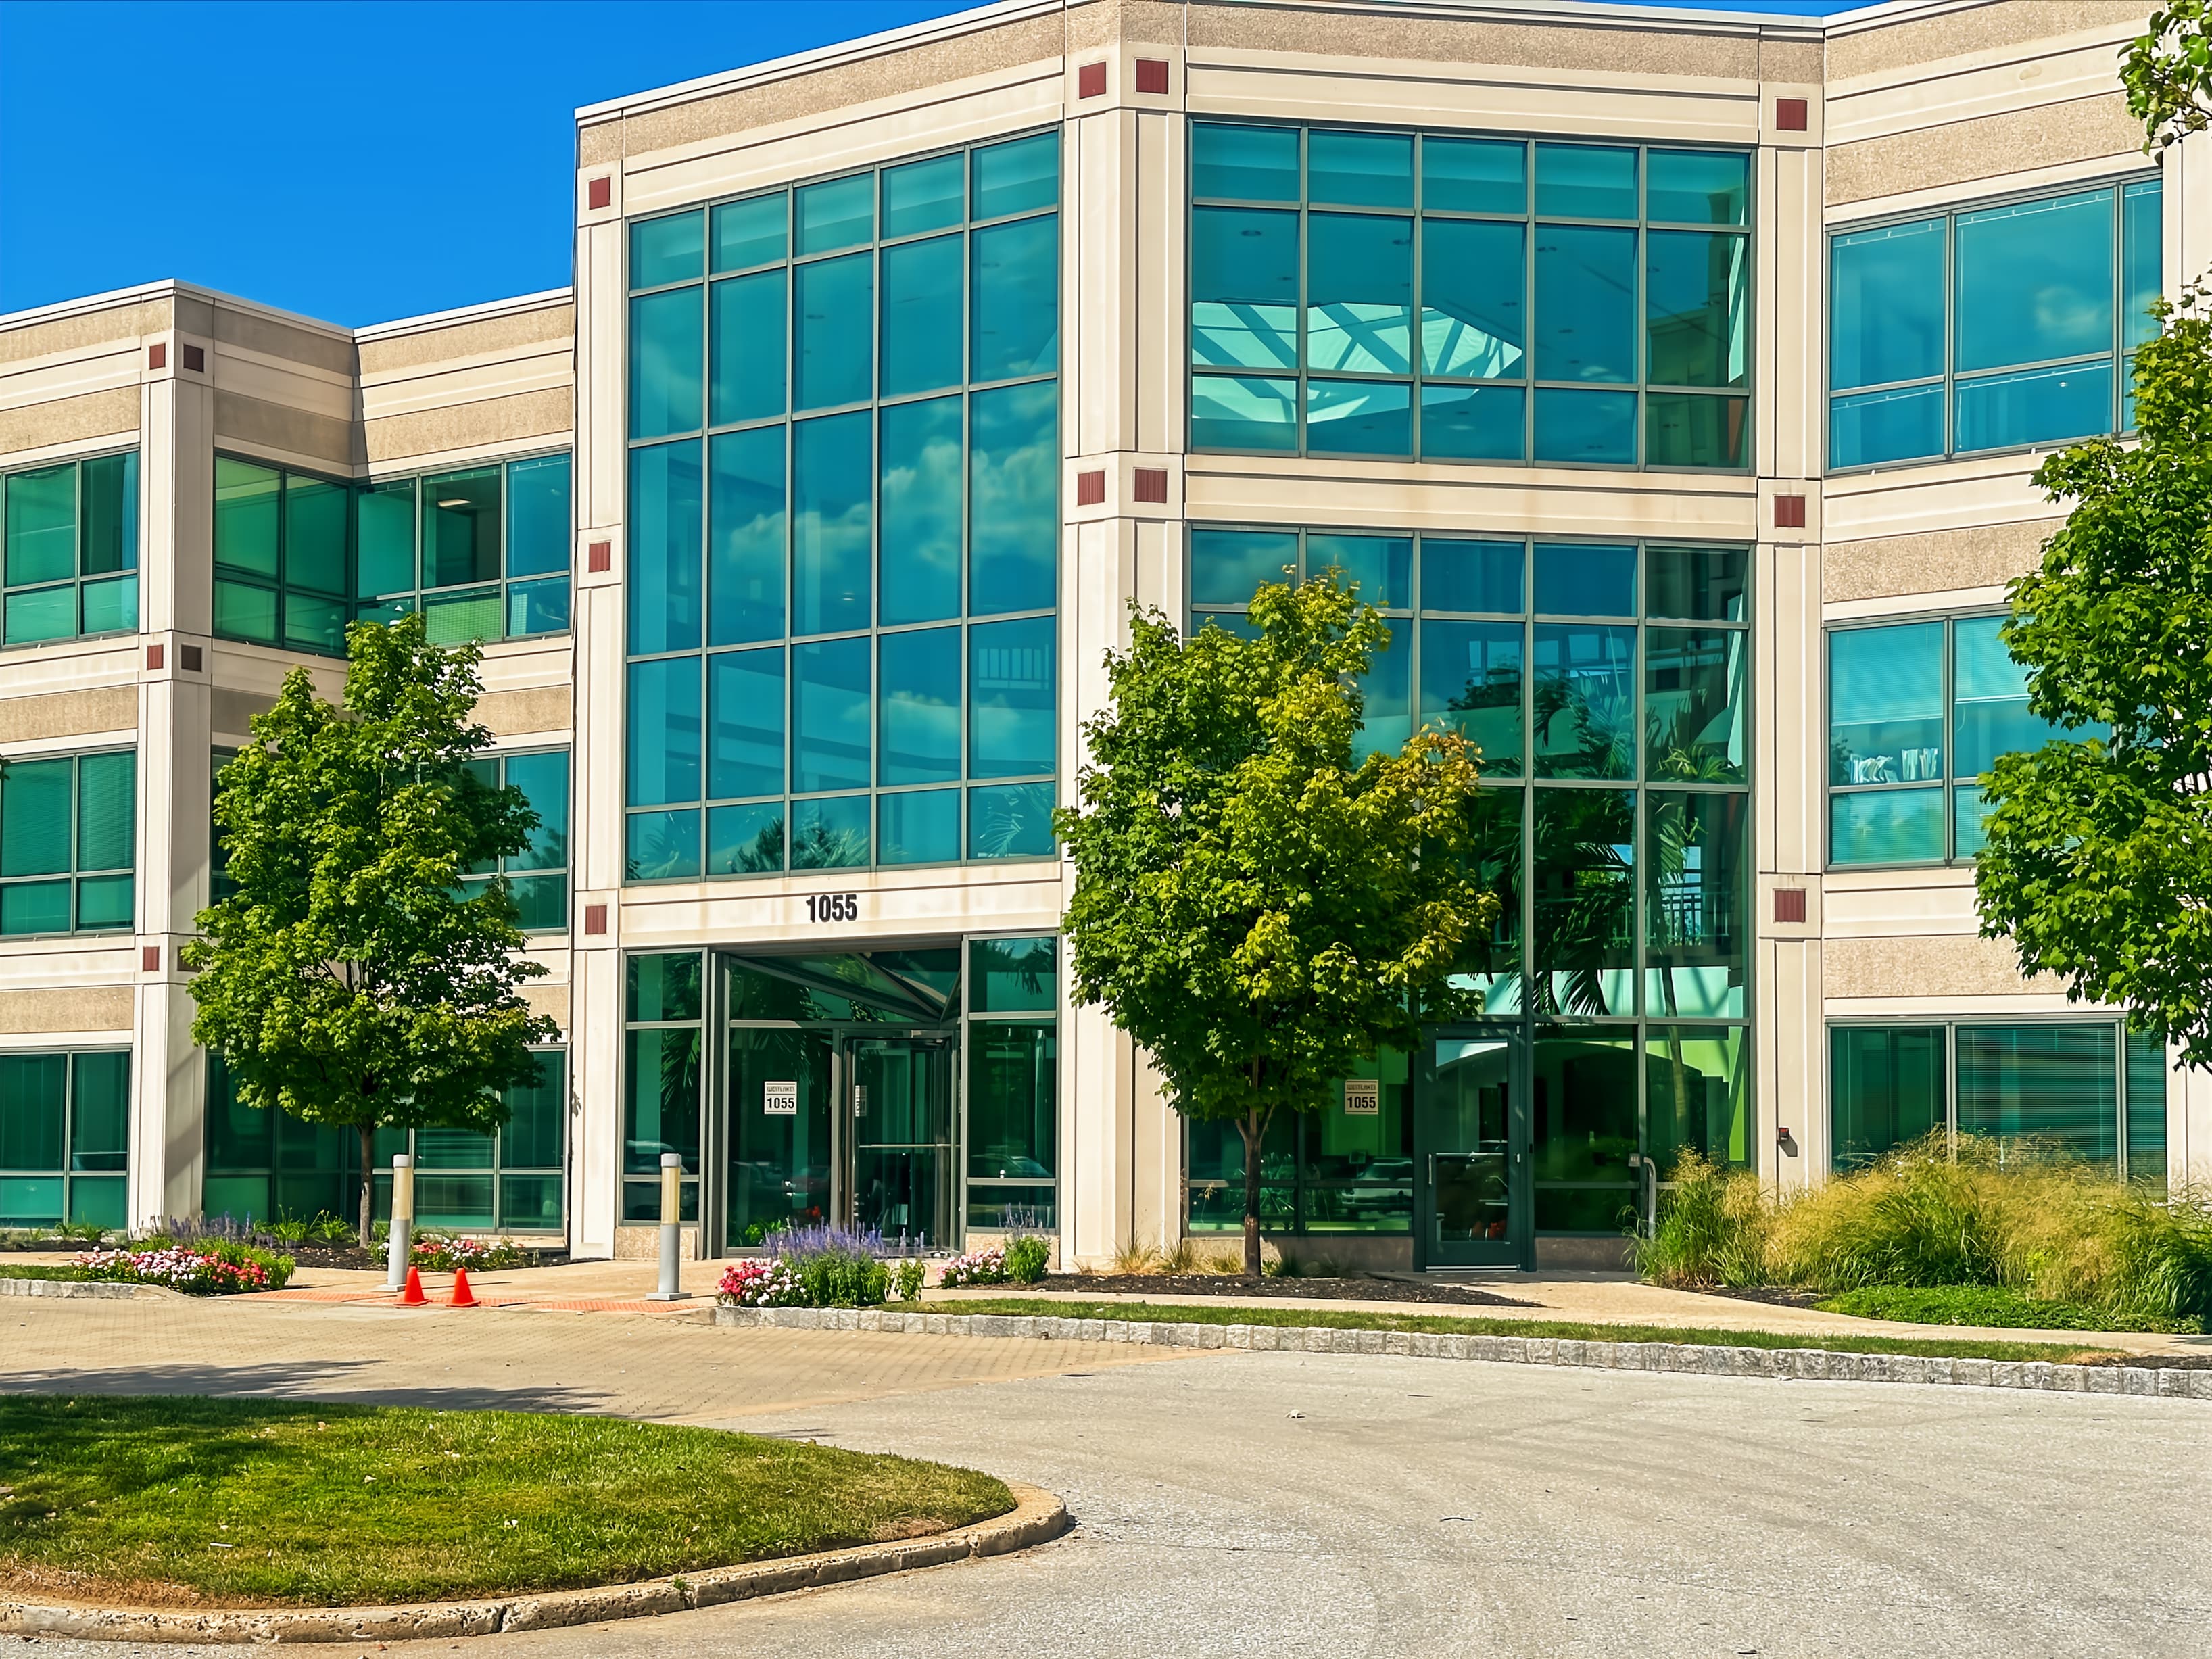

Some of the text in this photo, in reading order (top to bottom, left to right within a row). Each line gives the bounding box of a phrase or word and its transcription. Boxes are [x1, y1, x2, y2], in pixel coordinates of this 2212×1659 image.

[806, 894, 857, 923] 1055
[767, 1097, 794, 1109] 1055
[1347, 1097, 1376, 1108] 1055
